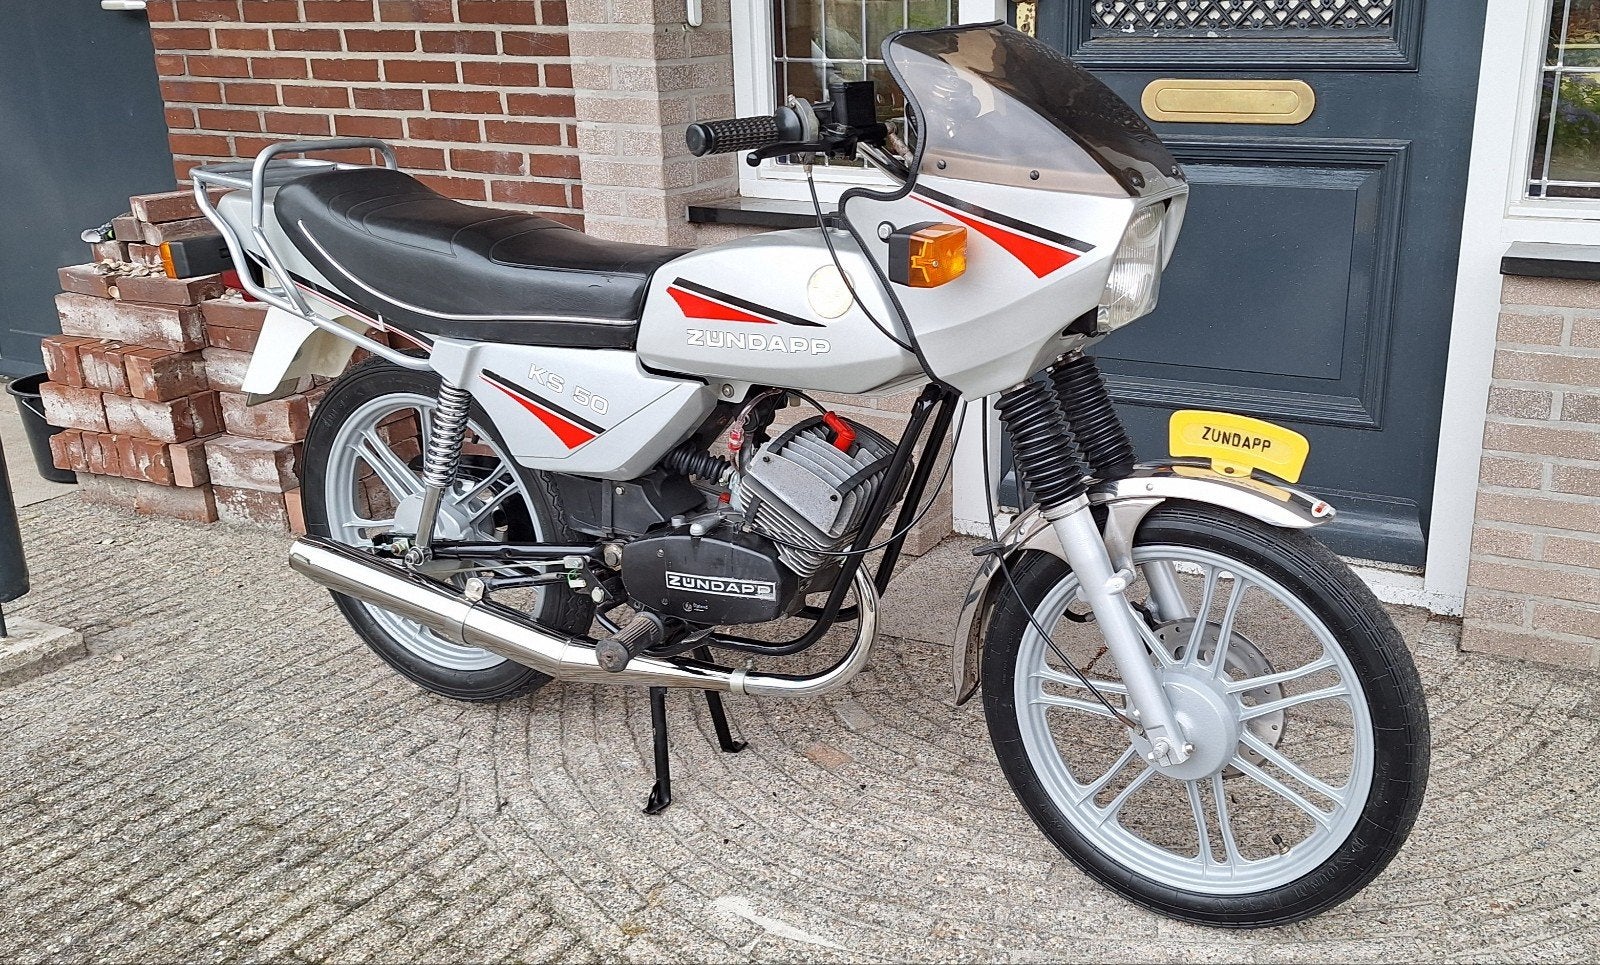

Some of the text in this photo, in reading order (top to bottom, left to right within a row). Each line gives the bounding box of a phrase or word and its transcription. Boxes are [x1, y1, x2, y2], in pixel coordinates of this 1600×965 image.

[687, 328, 832, 355] ZÜNDAPP
[527, 363, 609, 416] KS 50
[1202, 426, 1271, 452] ZUNDAPP
[669, 575, 772, 595] ZÜNDAPP
